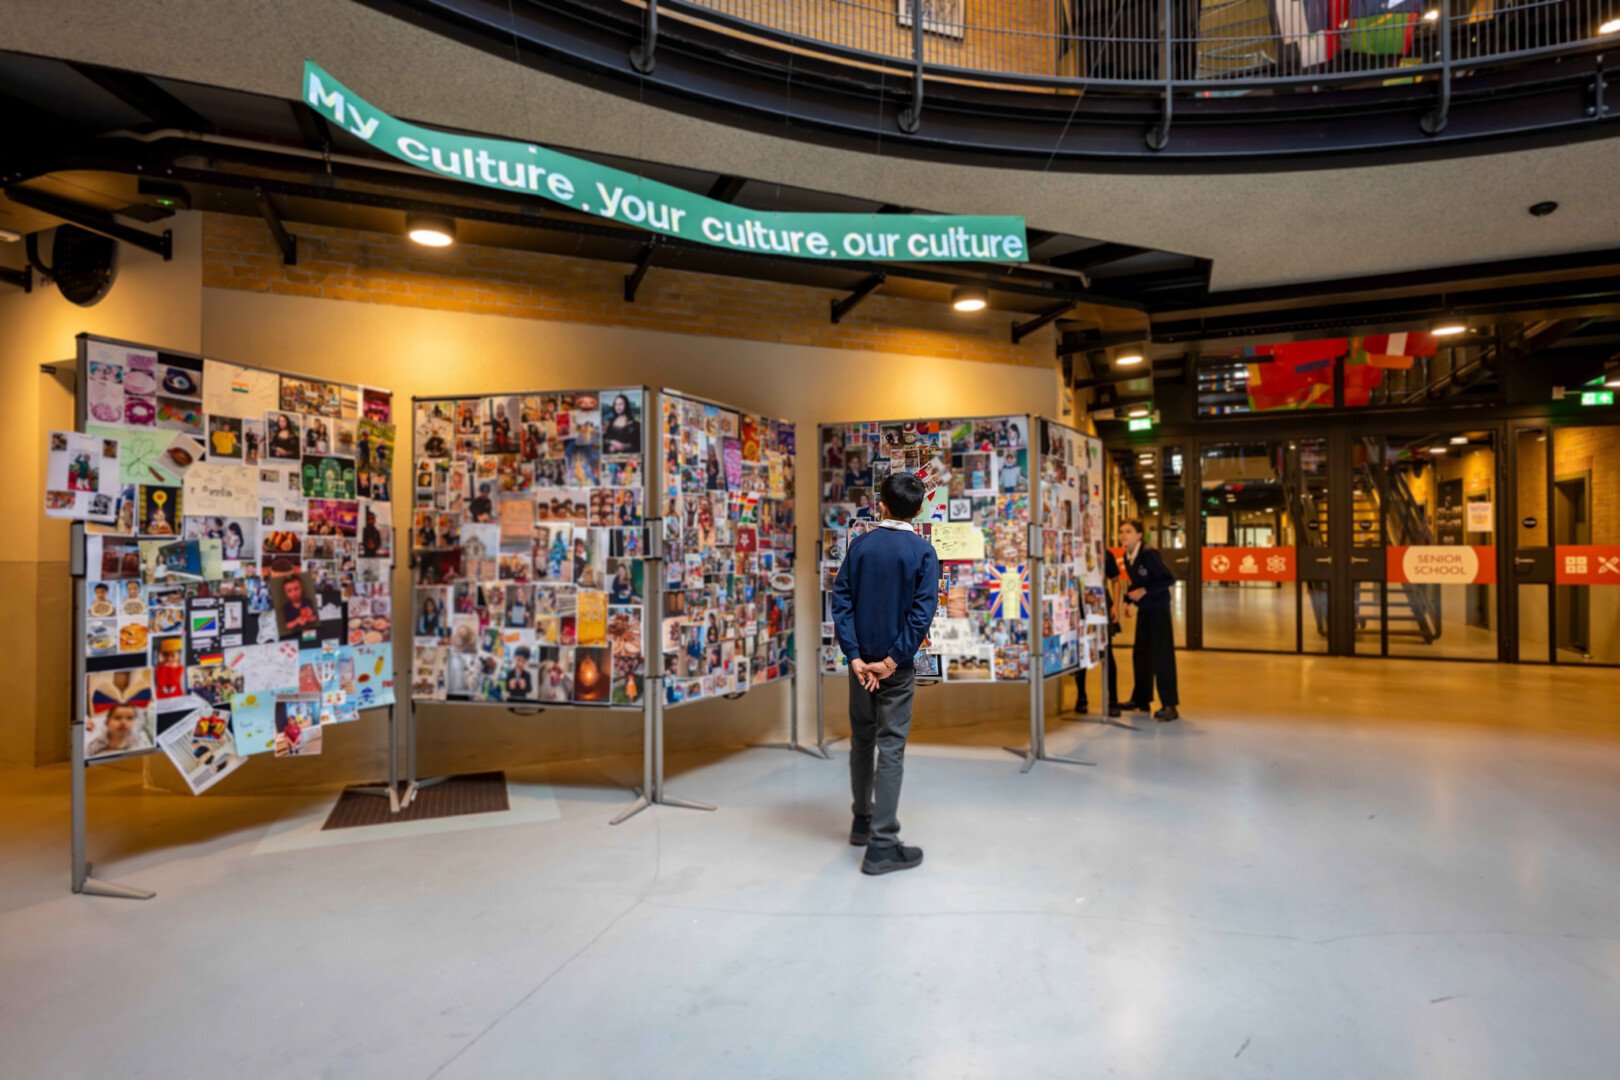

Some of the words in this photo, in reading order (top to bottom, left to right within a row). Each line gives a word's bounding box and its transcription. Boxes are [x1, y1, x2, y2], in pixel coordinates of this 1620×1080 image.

[308, 73, 379, 139] My
[595, 182, 686, 233] your
[843, 232, 900, 257] our
[907, 226, 1023, 258] culture
[1417, 554, 1463, 564] SENIOR
[1413, 565, 1467, 575] SCHOOL
